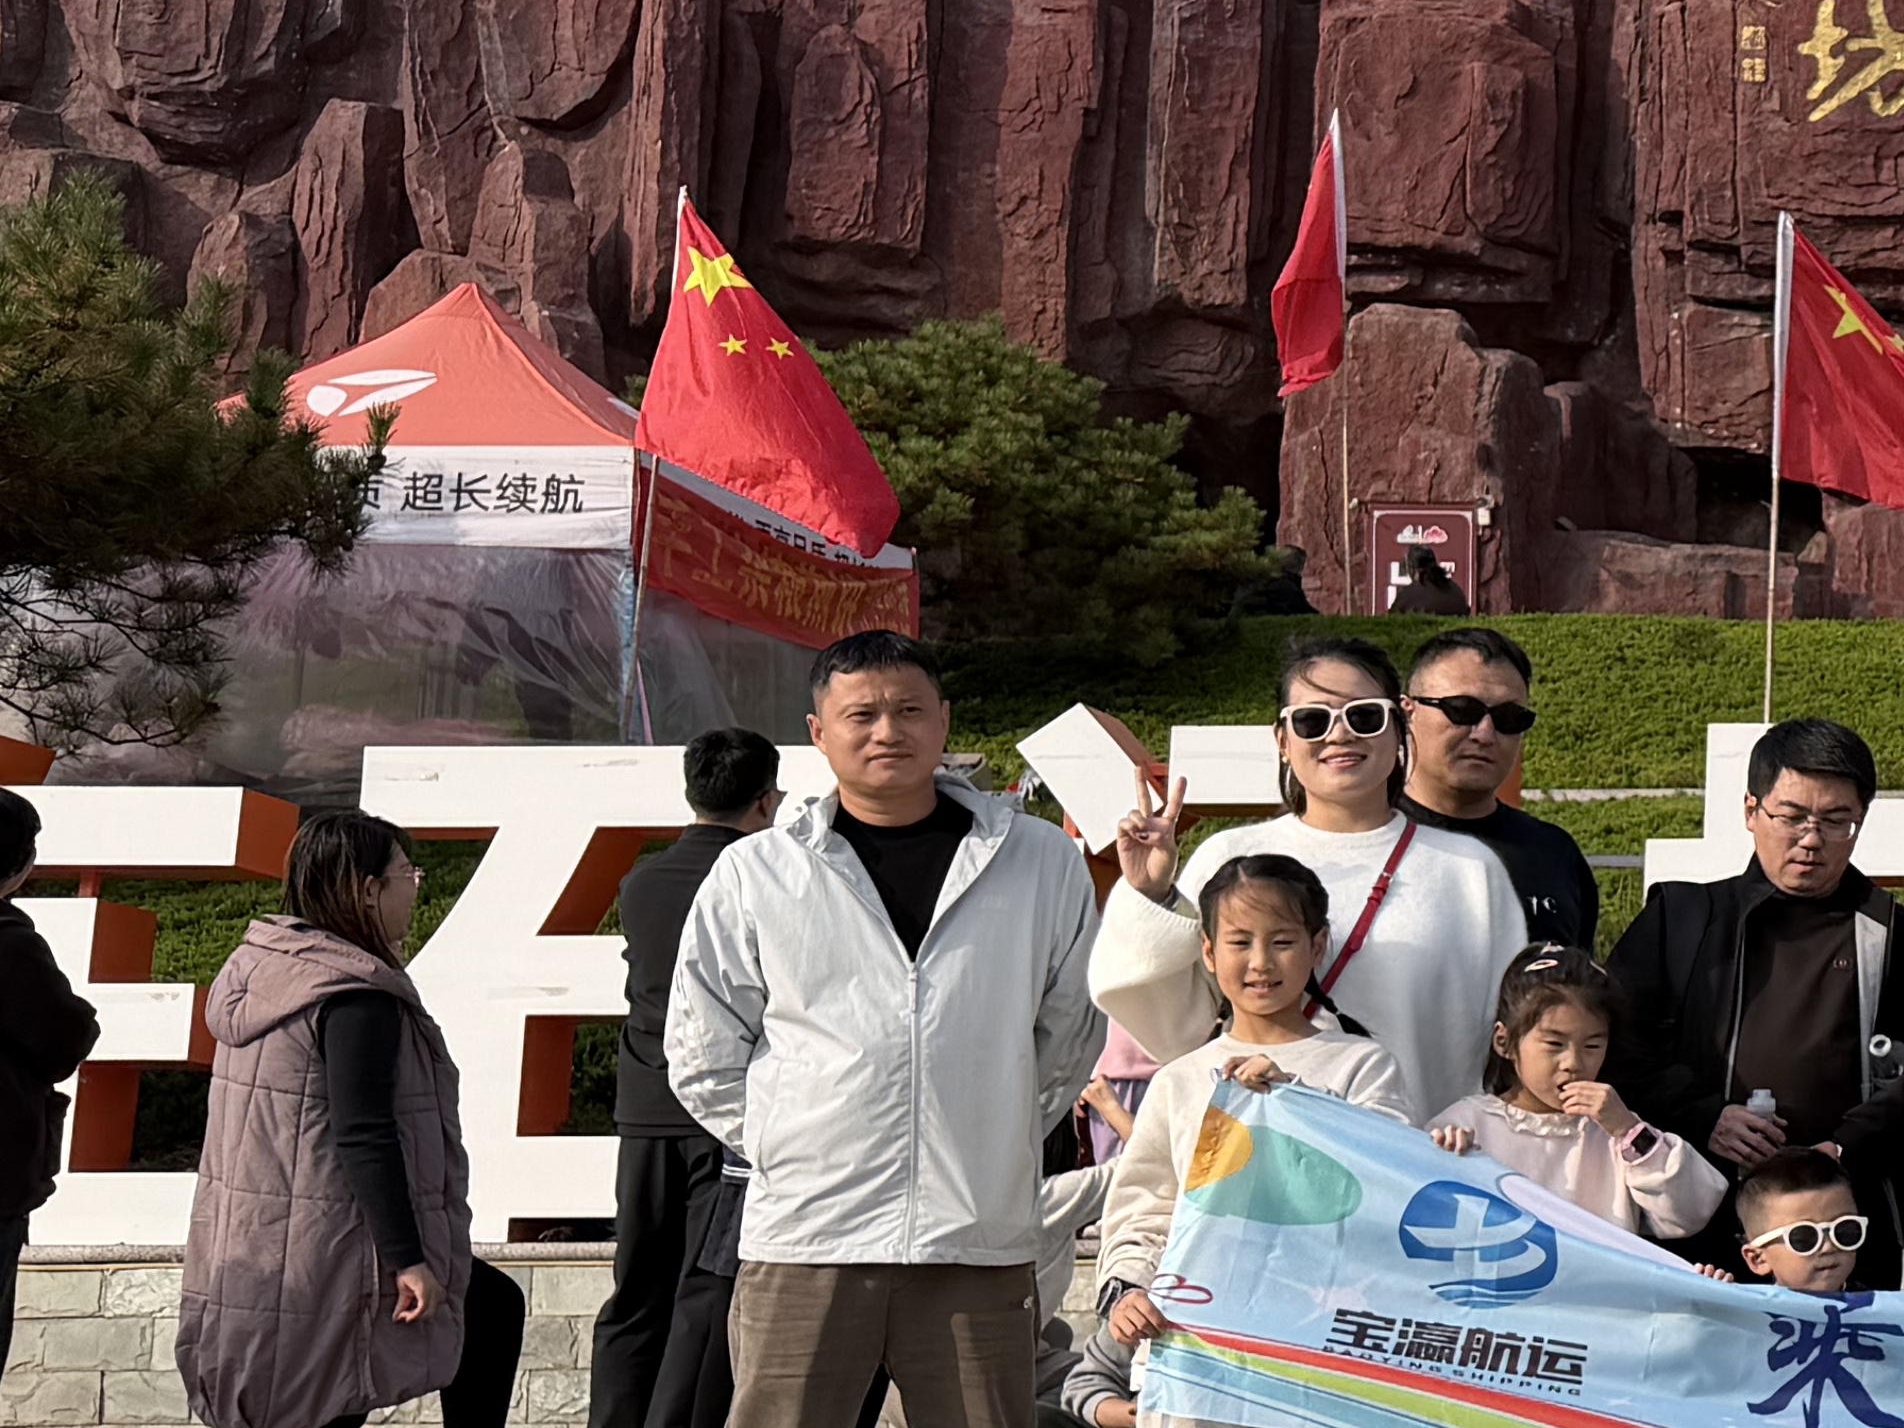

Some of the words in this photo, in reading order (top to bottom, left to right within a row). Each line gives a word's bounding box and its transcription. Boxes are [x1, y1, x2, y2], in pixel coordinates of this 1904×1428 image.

[400, 471, 586, 514] 超长续航
[1325, 1308, 1589, 1385] 宝瀛航运
